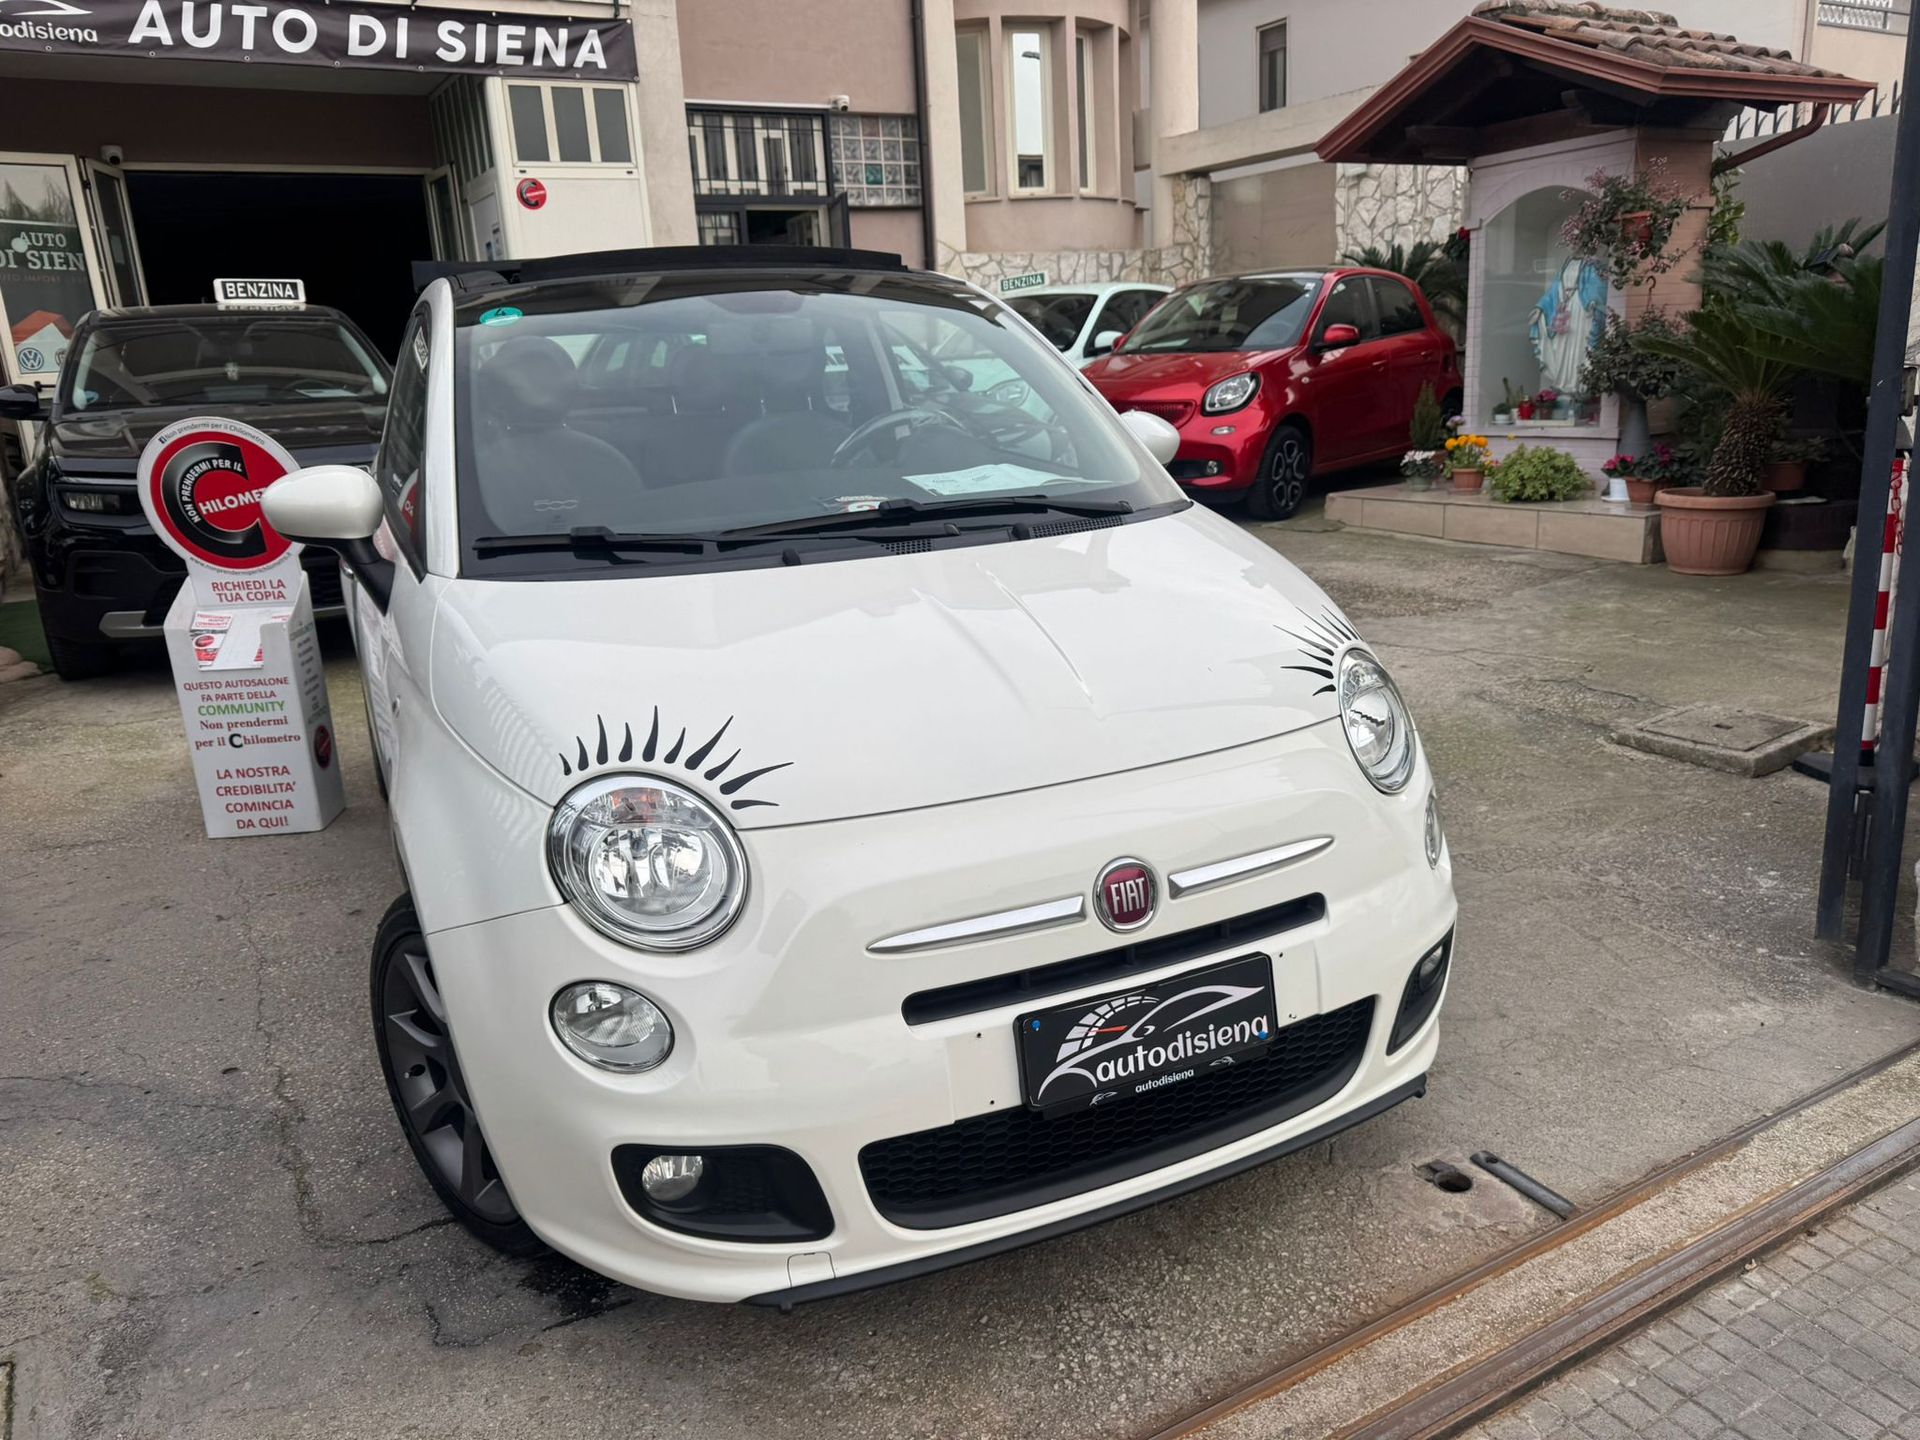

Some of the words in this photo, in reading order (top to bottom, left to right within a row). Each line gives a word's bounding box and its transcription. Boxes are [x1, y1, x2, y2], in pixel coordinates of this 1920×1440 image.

[128, 0, 318, 53] AUTO
[347, 14, 408, 59] DI
[435, 20, 608, 69] SIENA
[19, 231, 67, 248] AUTO
[225, 282, 295, 298] BENZINA
[1002, 274, 1042, 290] BENZINA
[212, 459, 231, 469] PER
[233, 461, 242, 472] IL
[181, 461, 211, 501] PRENDERMI
[183, 503, 201, 523] NON
[211, 580, 266, 592] RICHIEDI
[269, 579, 286, 589] LA
[216, 592, 244, 603] TUA
[246, 590, 286, 601] COPIA
[183, 680, 222, 691] QUESTO
[224, 677, 289, 689] AUTOSALONE
[201, 694, 213, 702] FA
[215, 691, 245, 702] PARTE
[247, 690, 277, 700] DELLA
[197, 701, 285, 716] COMMUNITY
[200, 720, 224, 731] Non
[226, 715, 289, 732] prendermi
[195, 739, 214, 750] per
[217, 737, 226, 747] il
[228, 733, 301, 749] Chilometro
[216, 769, 233, 780] LA
[235, 765, 290, 778] NOSTRA
[225, 799, 295, 813] COMINCIA
[236, 818, 256, 829] DA
[258, 816, 289, 829] QUI!
[1109, 877, 1147, 915] FIAT
[1096, 1014, 1268, 1082] autodisiena
[1135, 1068, 1194, 1093] autodisiena
